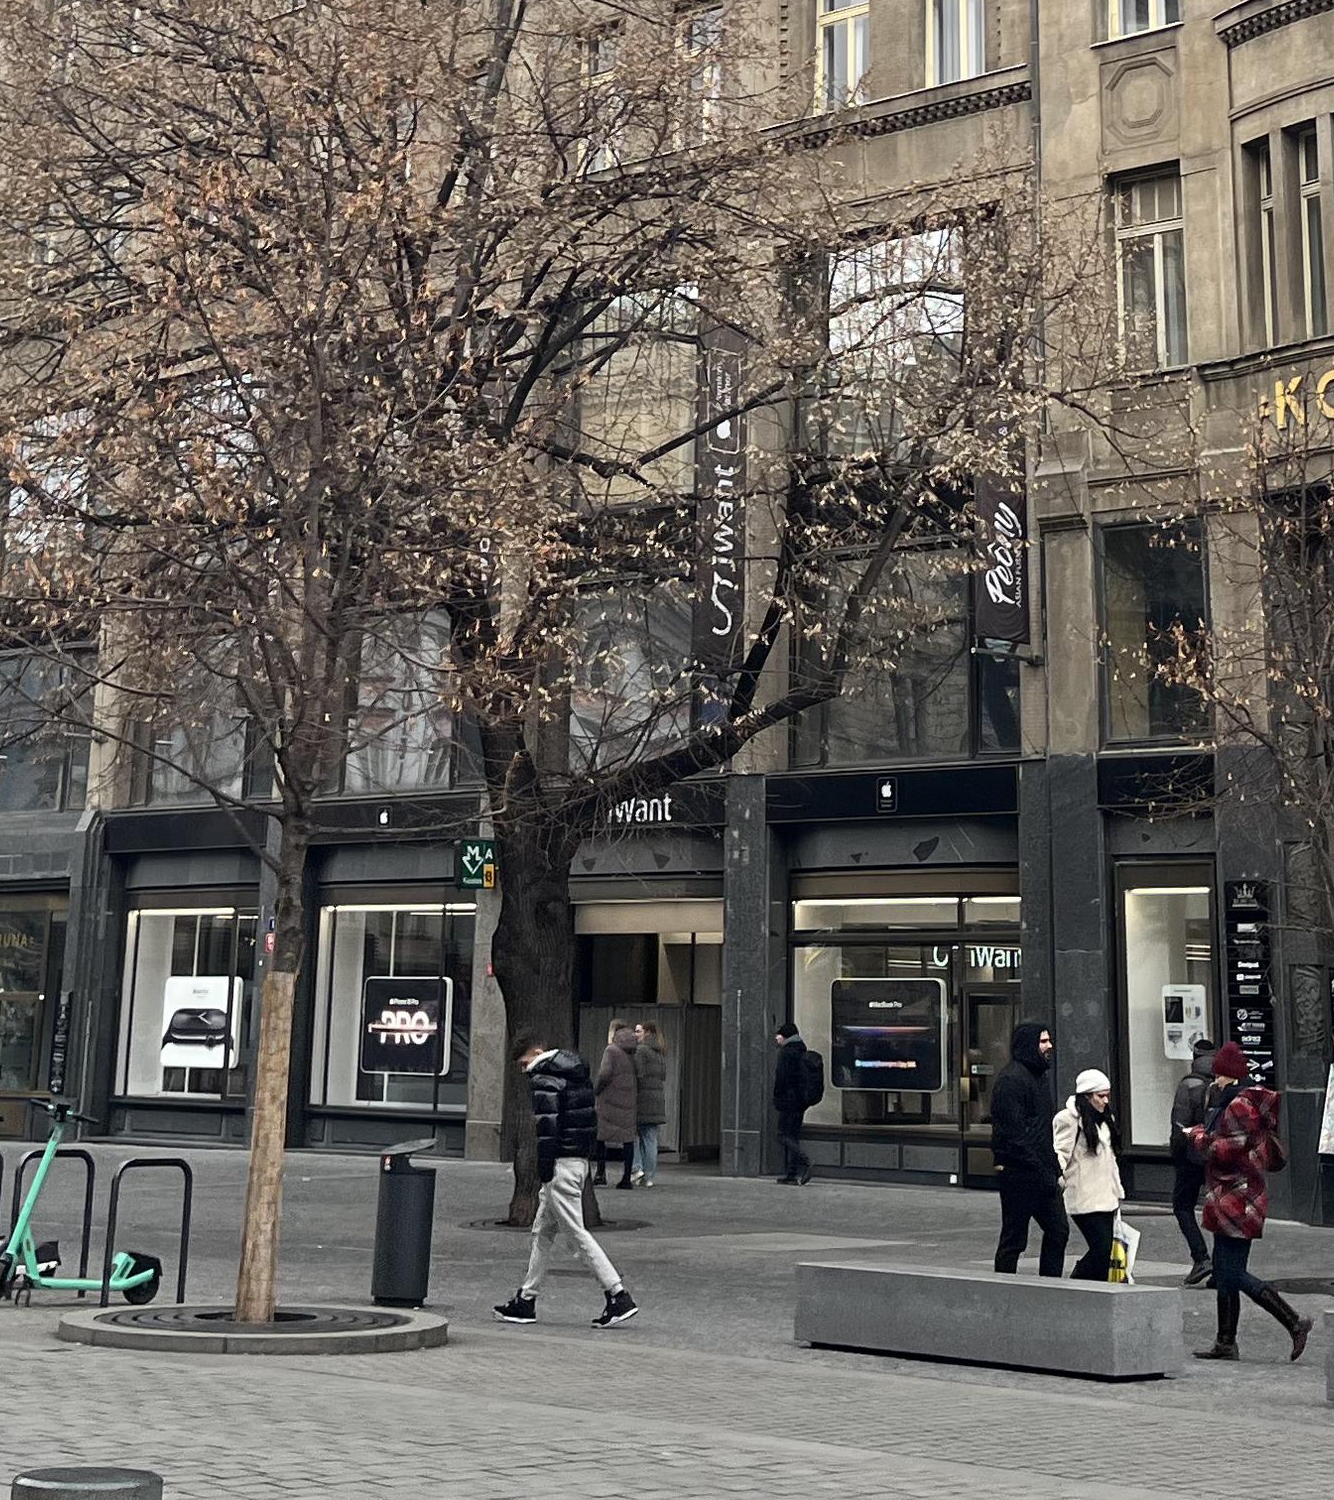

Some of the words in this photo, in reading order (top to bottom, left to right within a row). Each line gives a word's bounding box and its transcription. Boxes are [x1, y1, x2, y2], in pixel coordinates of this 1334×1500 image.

[484, 847, 494, 860] A
[970, 946, 1022, 968] iWan
[380, 1010, 430, 1045] PRO
